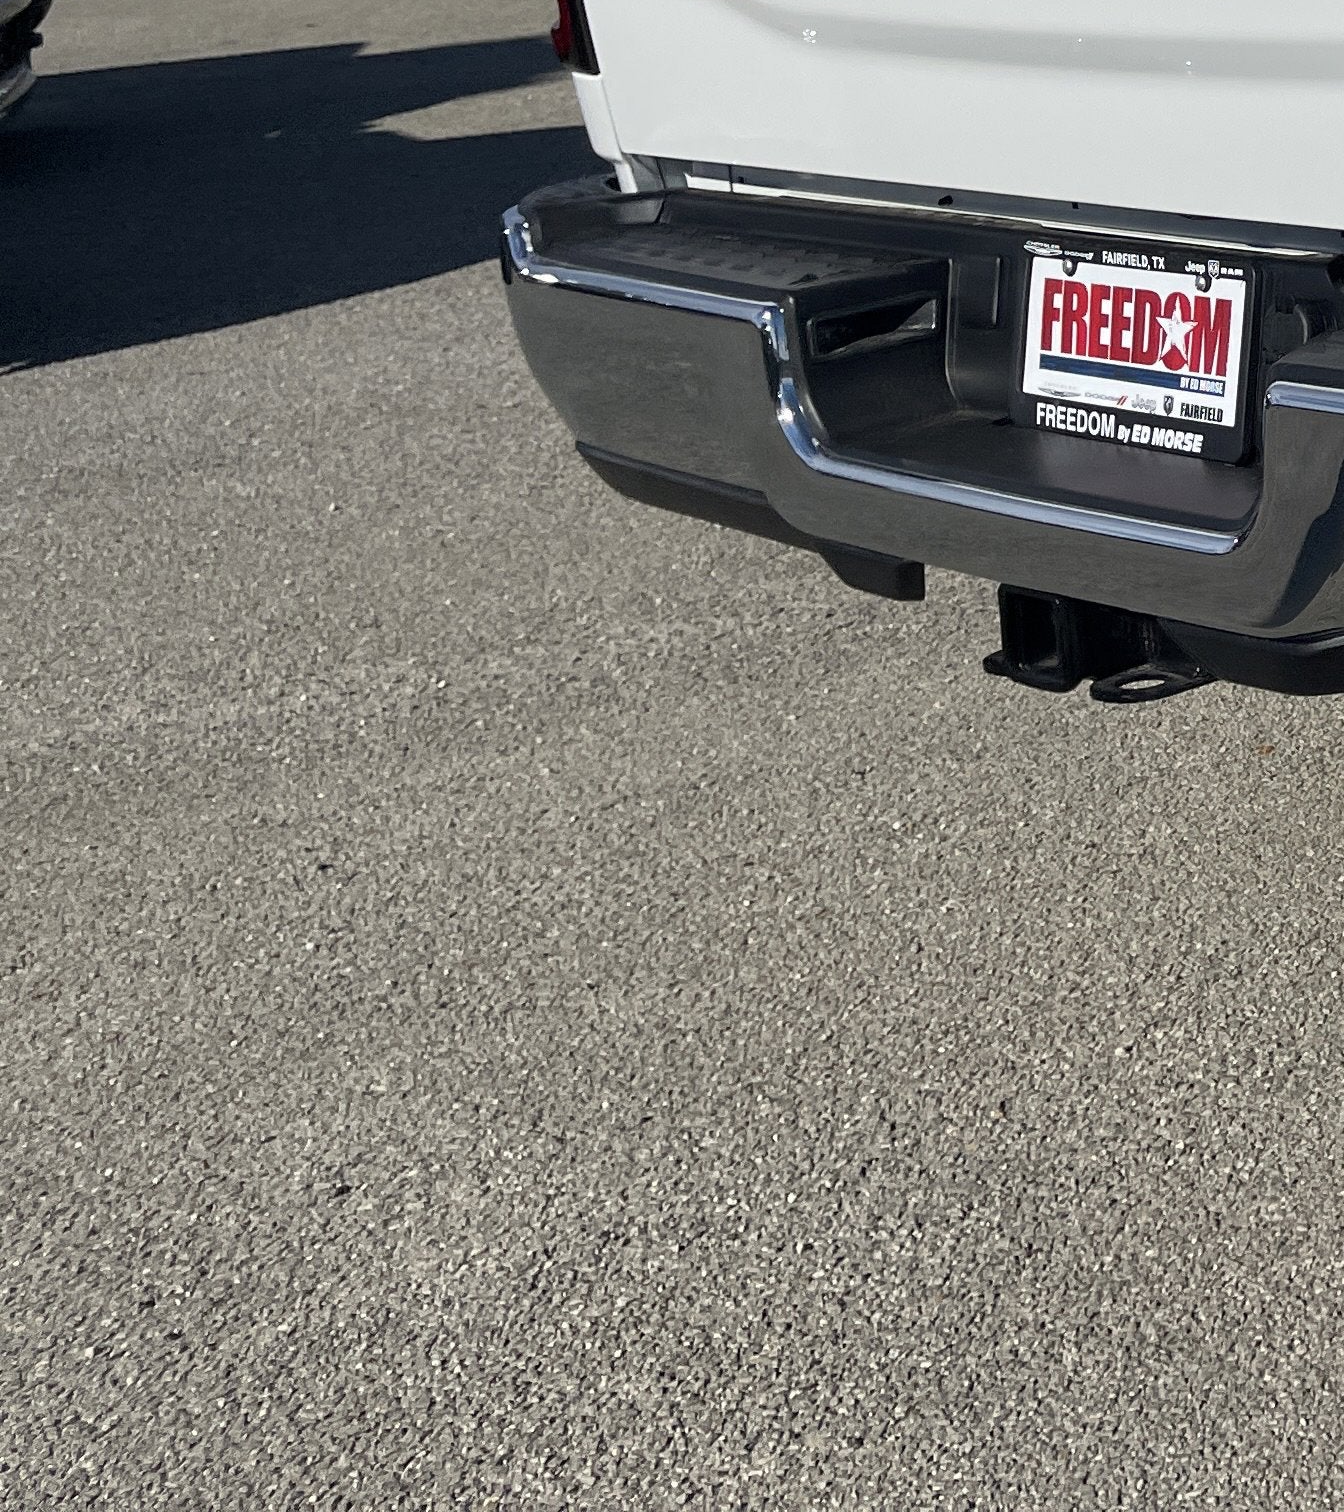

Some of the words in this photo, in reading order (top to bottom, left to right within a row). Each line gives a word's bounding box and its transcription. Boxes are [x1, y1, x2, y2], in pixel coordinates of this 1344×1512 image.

[1102, 250, 1151, 270] FAIRFIELD,
[1152, 256, 1165, 270] TX
[1184, 261, 1206, 275] Jeep
[1040, 278, 1232, 376] FREEDOM
[1180, 377, 1190, 389] BY
[1190, 378, 1200, 391] ED
[1131, 394, 1157, 414] Jeep
[1180, 402, 1224, 423] FAIRFIELD
[1036, 402, 1116, 438] FREEDOM
[1131, 424, 1151, 444] ED
[1151, 426, 1204, 453] MORSE
